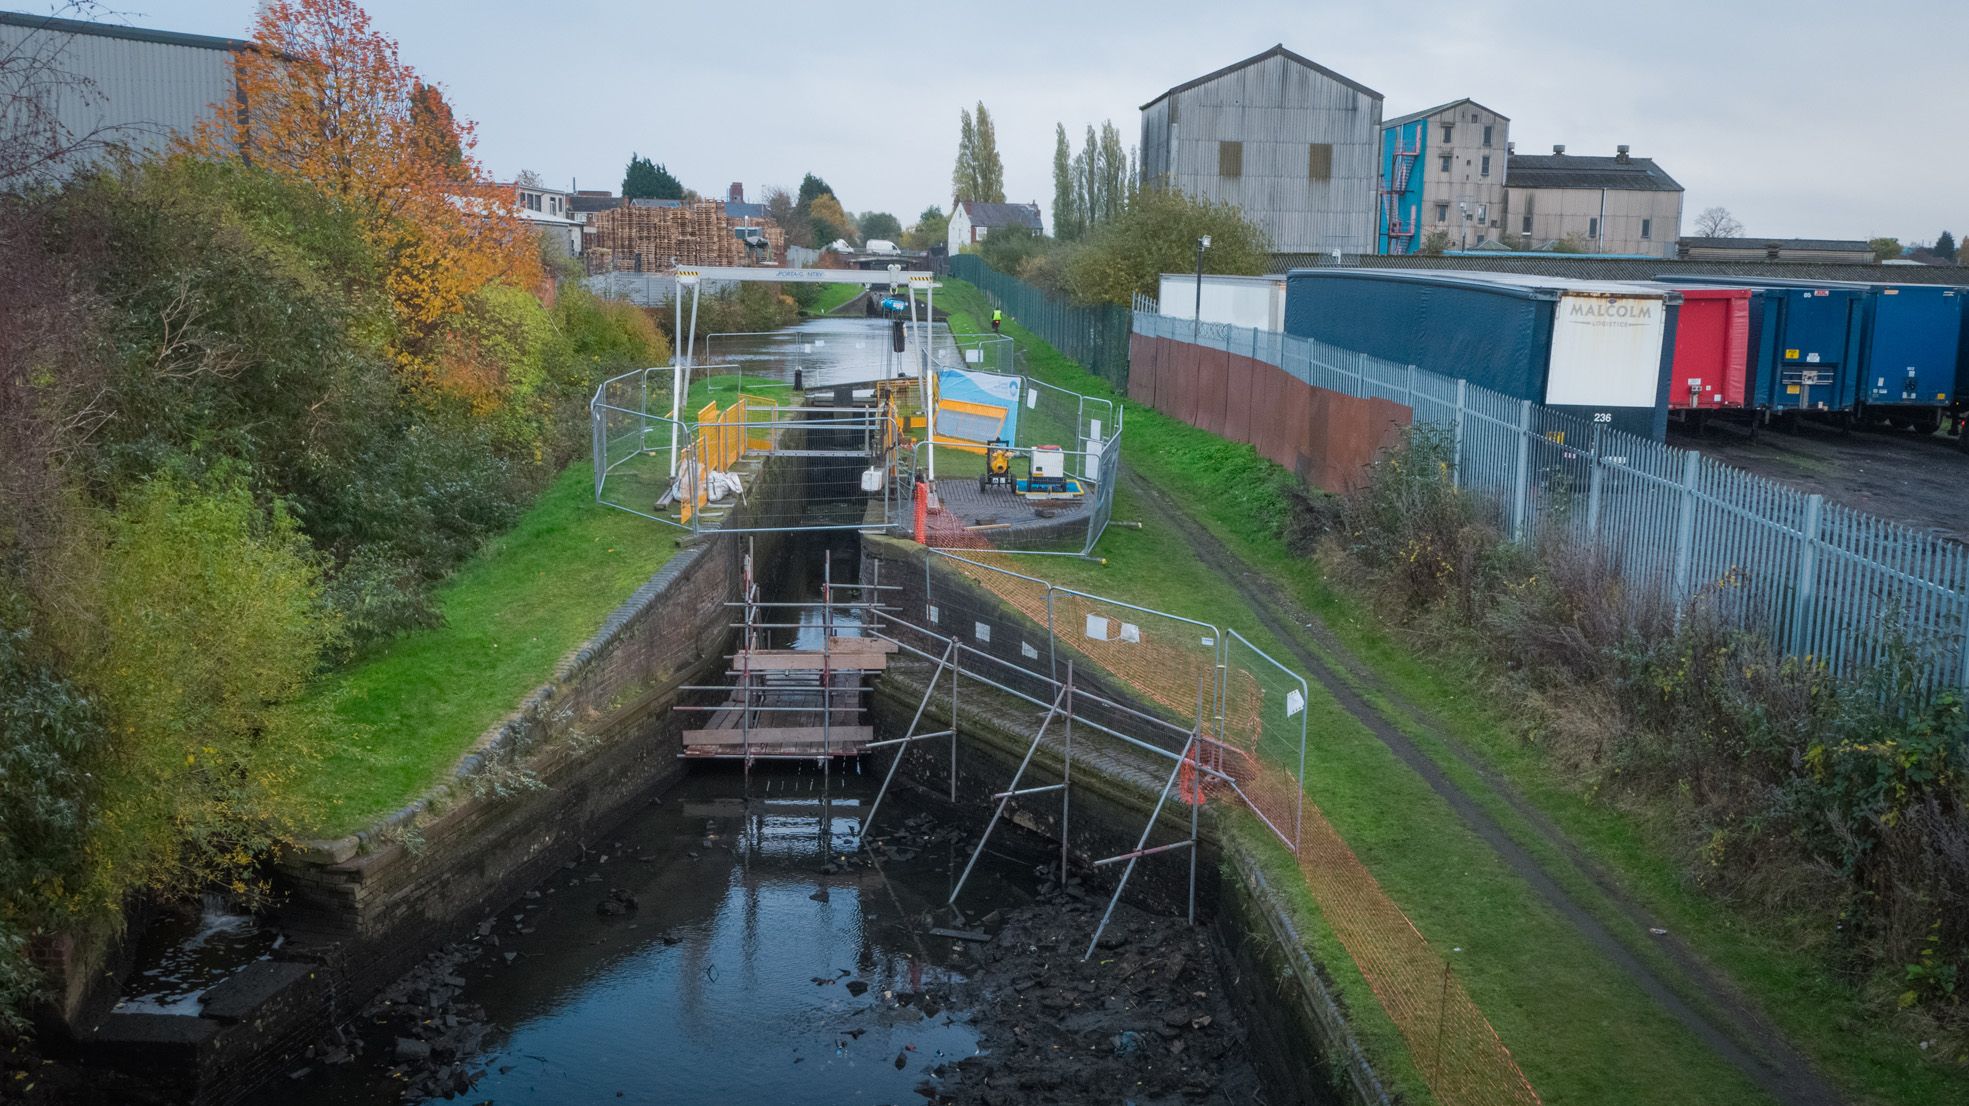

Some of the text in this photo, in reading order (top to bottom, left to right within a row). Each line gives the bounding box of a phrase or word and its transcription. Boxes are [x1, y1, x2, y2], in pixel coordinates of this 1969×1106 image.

[1570, 304, 1651, 318] MALCOLM
[1592, 320, 1628, 328] LOGISTICS
[1594, 413, 1612, 422] 236
